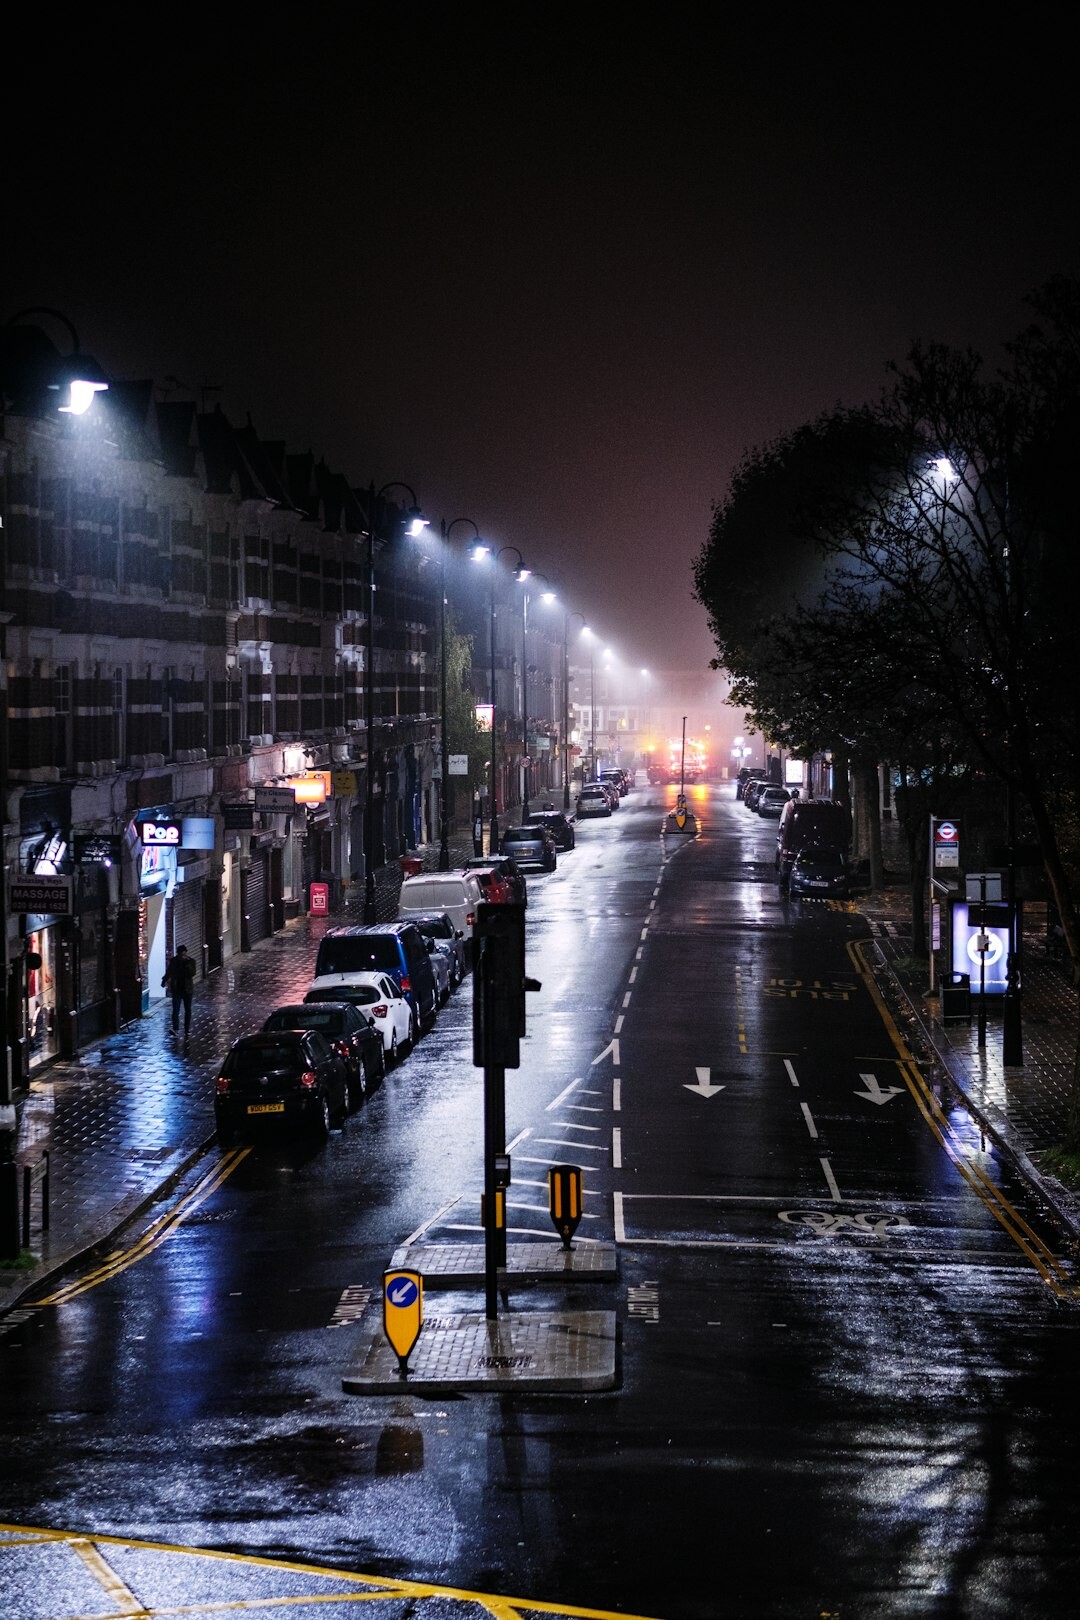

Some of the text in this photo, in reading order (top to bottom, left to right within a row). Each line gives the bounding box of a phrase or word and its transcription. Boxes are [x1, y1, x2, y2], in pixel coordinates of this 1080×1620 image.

[256, 789, 267, 797] Dry
[143, 822, 180, 840] Pop
[17, 876, 63, 886] Relaxing Ways
[13, 889, 67, 900] MASSAGE
[763, 987, 850, 1001] BUS
